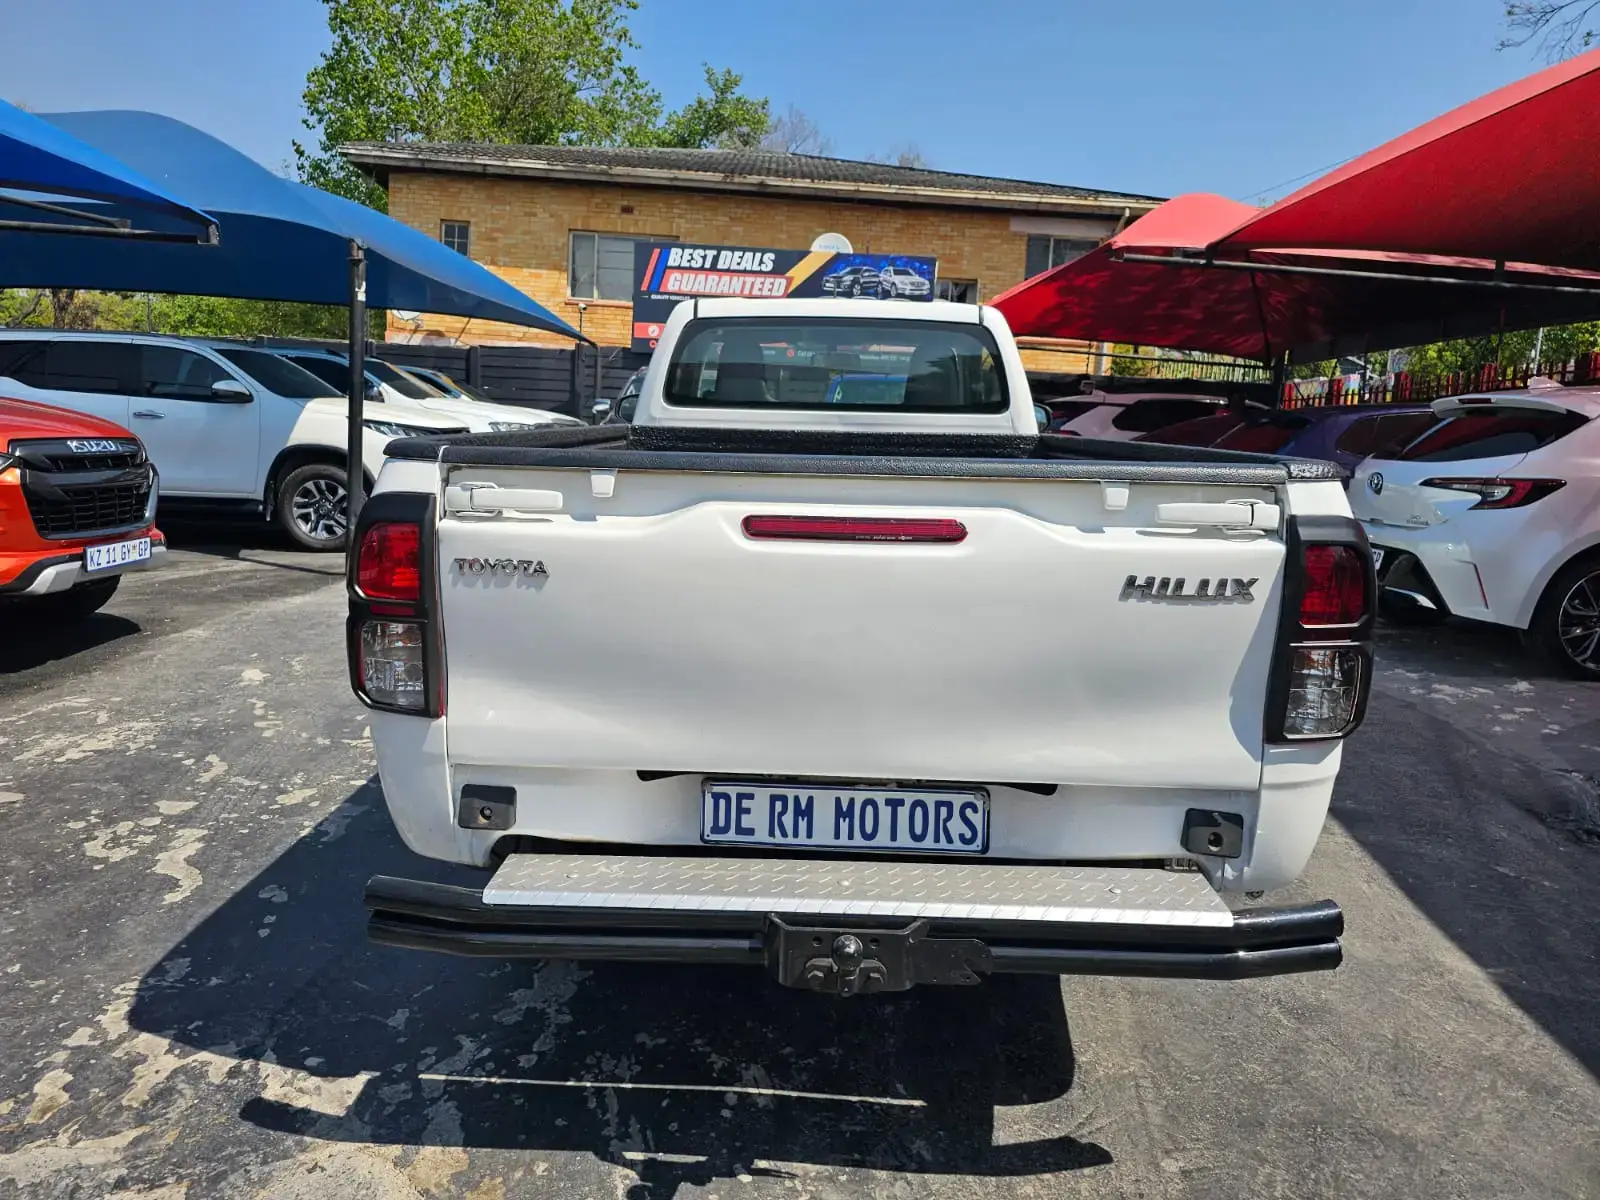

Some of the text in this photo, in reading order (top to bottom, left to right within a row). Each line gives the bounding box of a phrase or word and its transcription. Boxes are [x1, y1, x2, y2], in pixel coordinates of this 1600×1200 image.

[667, 247, 775, 272] BEST DEALS
[667, 272, 787, 297] GUARANTEED
[67, 440, 121, 453] ISUZU
[89, 540, 149, 568] KZ 11 GY GP
[453, 558, 550, 577] TOYOTA
[1119, 575, 1259, 602] HILUX
[709, 791, 980, 846] DE RM MOTORS
